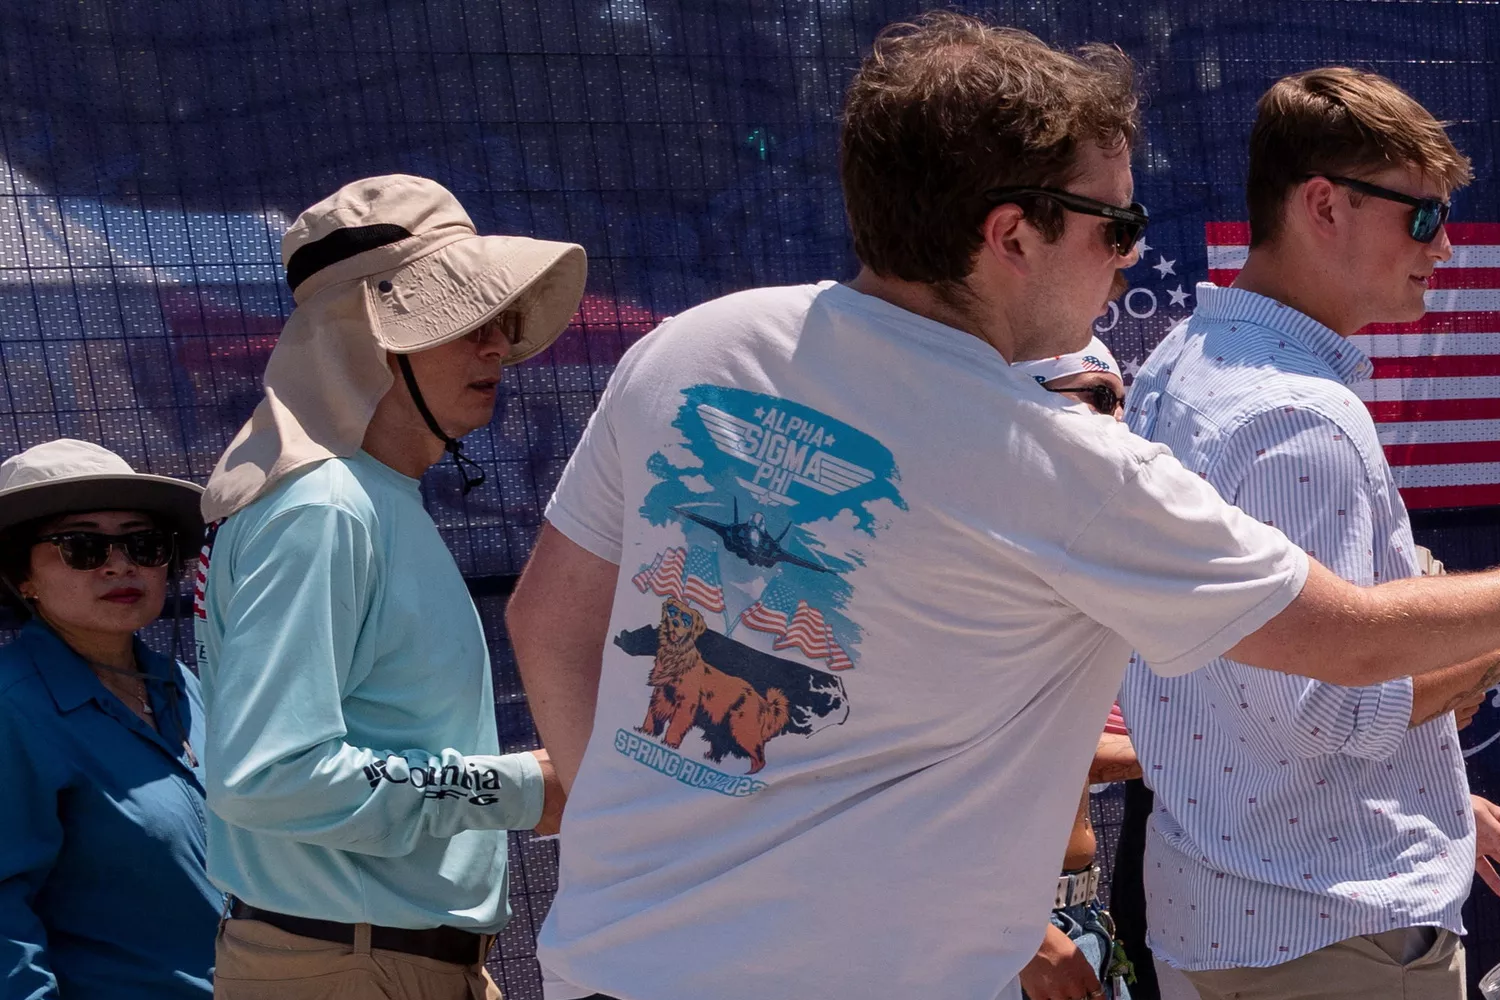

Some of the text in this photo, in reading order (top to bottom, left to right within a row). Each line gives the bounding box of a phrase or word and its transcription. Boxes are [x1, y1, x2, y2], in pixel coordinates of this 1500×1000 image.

[761, 407, 825, 447] ALPHA
[739, 427, 822, 482] SIGMA
[752, 462, 794, 496] PHI
[615, 730, 681, 777] SPRING
[679, 760, 722, 788] RUSH
